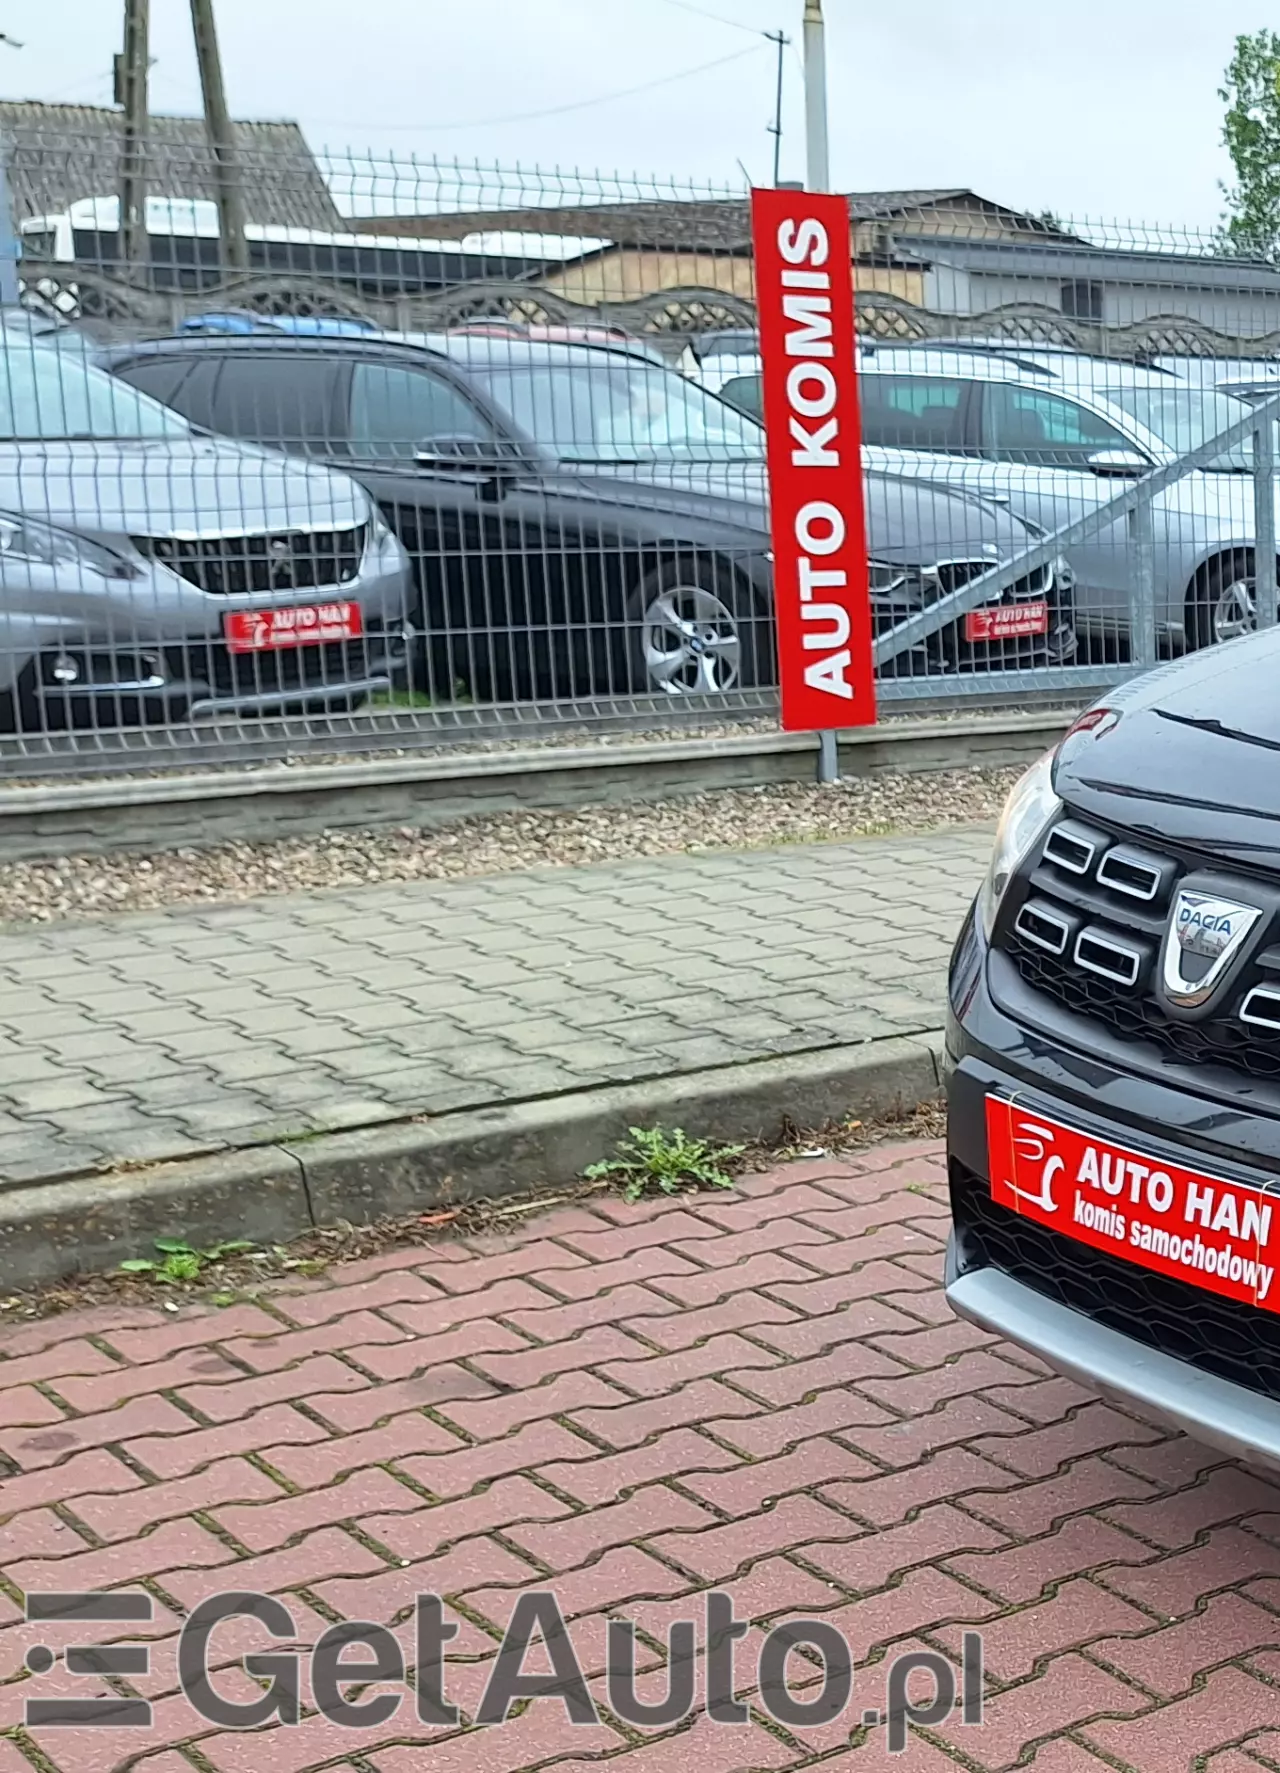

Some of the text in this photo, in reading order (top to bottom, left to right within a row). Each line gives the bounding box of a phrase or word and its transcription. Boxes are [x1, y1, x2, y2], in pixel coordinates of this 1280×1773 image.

[777, 217, 854, 700] AUTO KOMIS
[1180, 908, 1231, 936] DACIA
[1073, 1190, 1274, 1300] komis samochodowy
[1076, 1146, 1272, 1246] AUTO HAN
